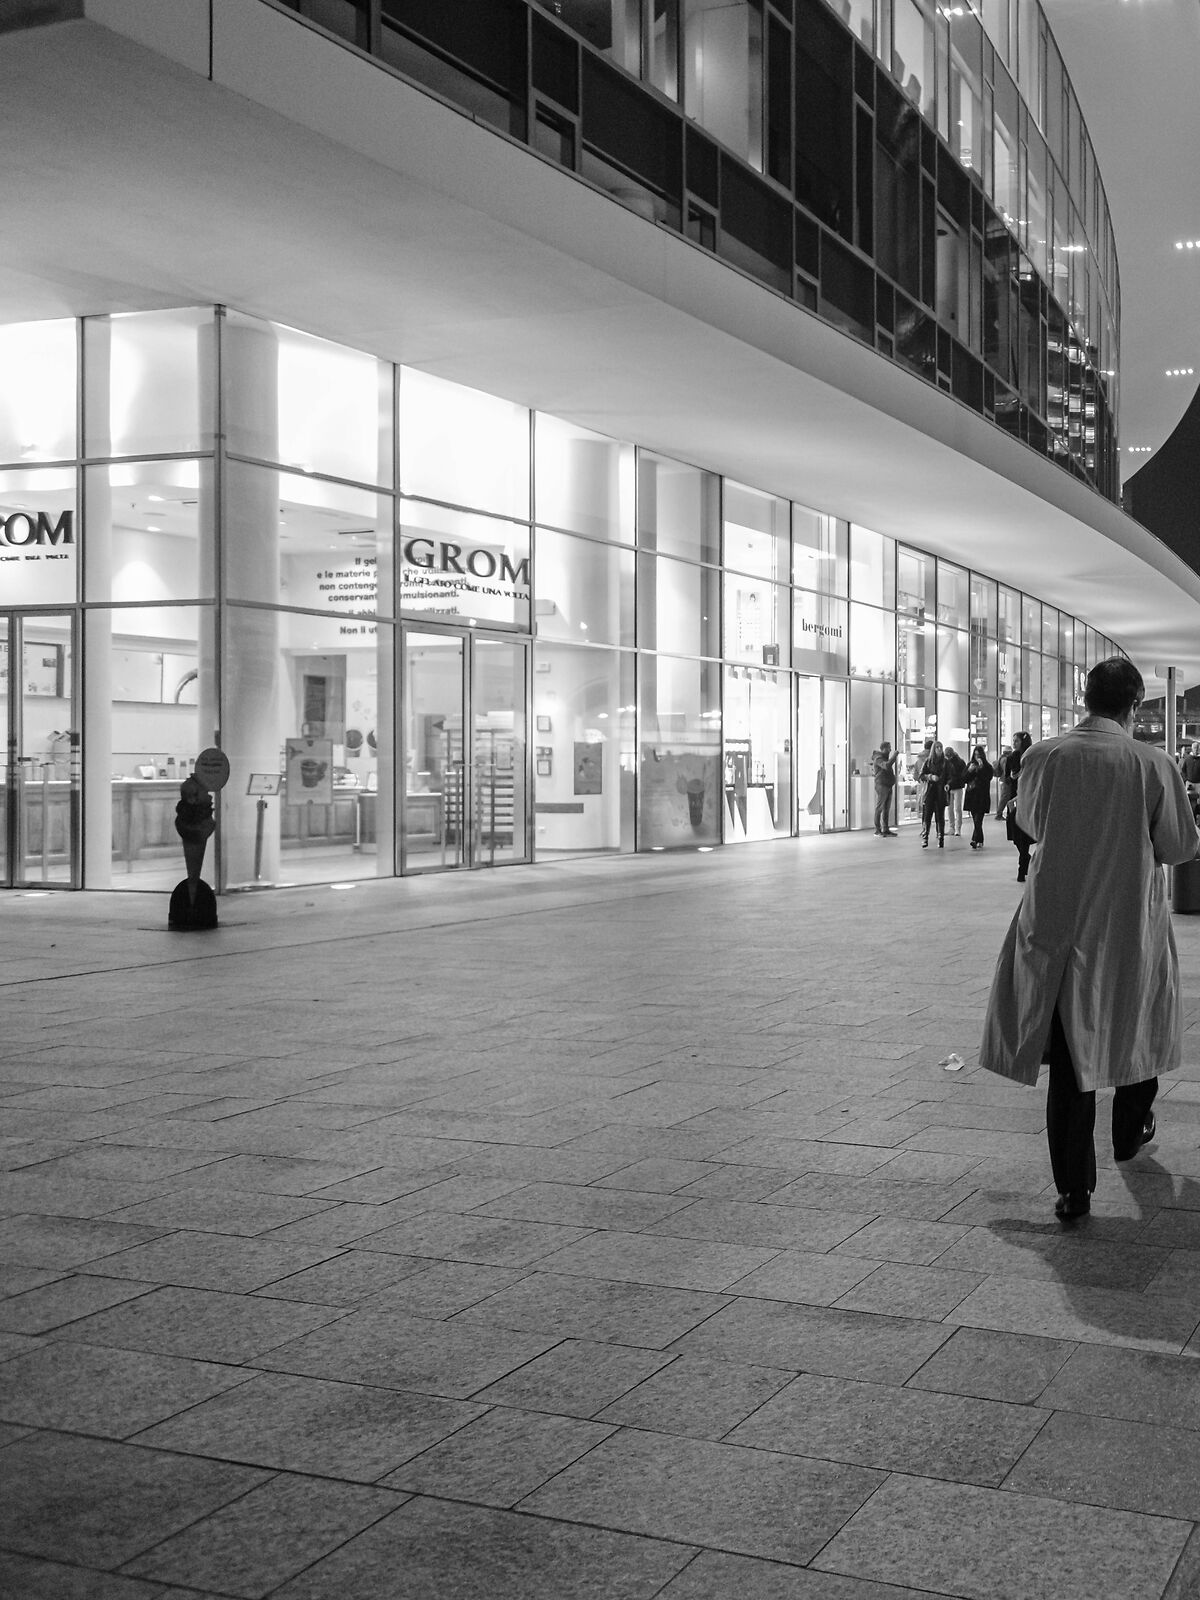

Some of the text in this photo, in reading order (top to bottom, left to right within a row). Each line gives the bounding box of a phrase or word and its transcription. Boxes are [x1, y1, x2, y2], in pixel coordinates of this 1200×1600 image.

[0, 510, 74, 546] OM
[404, 538, 530, 585] GROM
[336, 570, 371, 578] materie
[319, 583, 336, 591] non
[482, 586, 502, 597] UNA
[328, 589, 460, 602] conservant mulsionanti.
[340, 626, 358, 635] Non
[802, 618, 843, 639] bergomi
